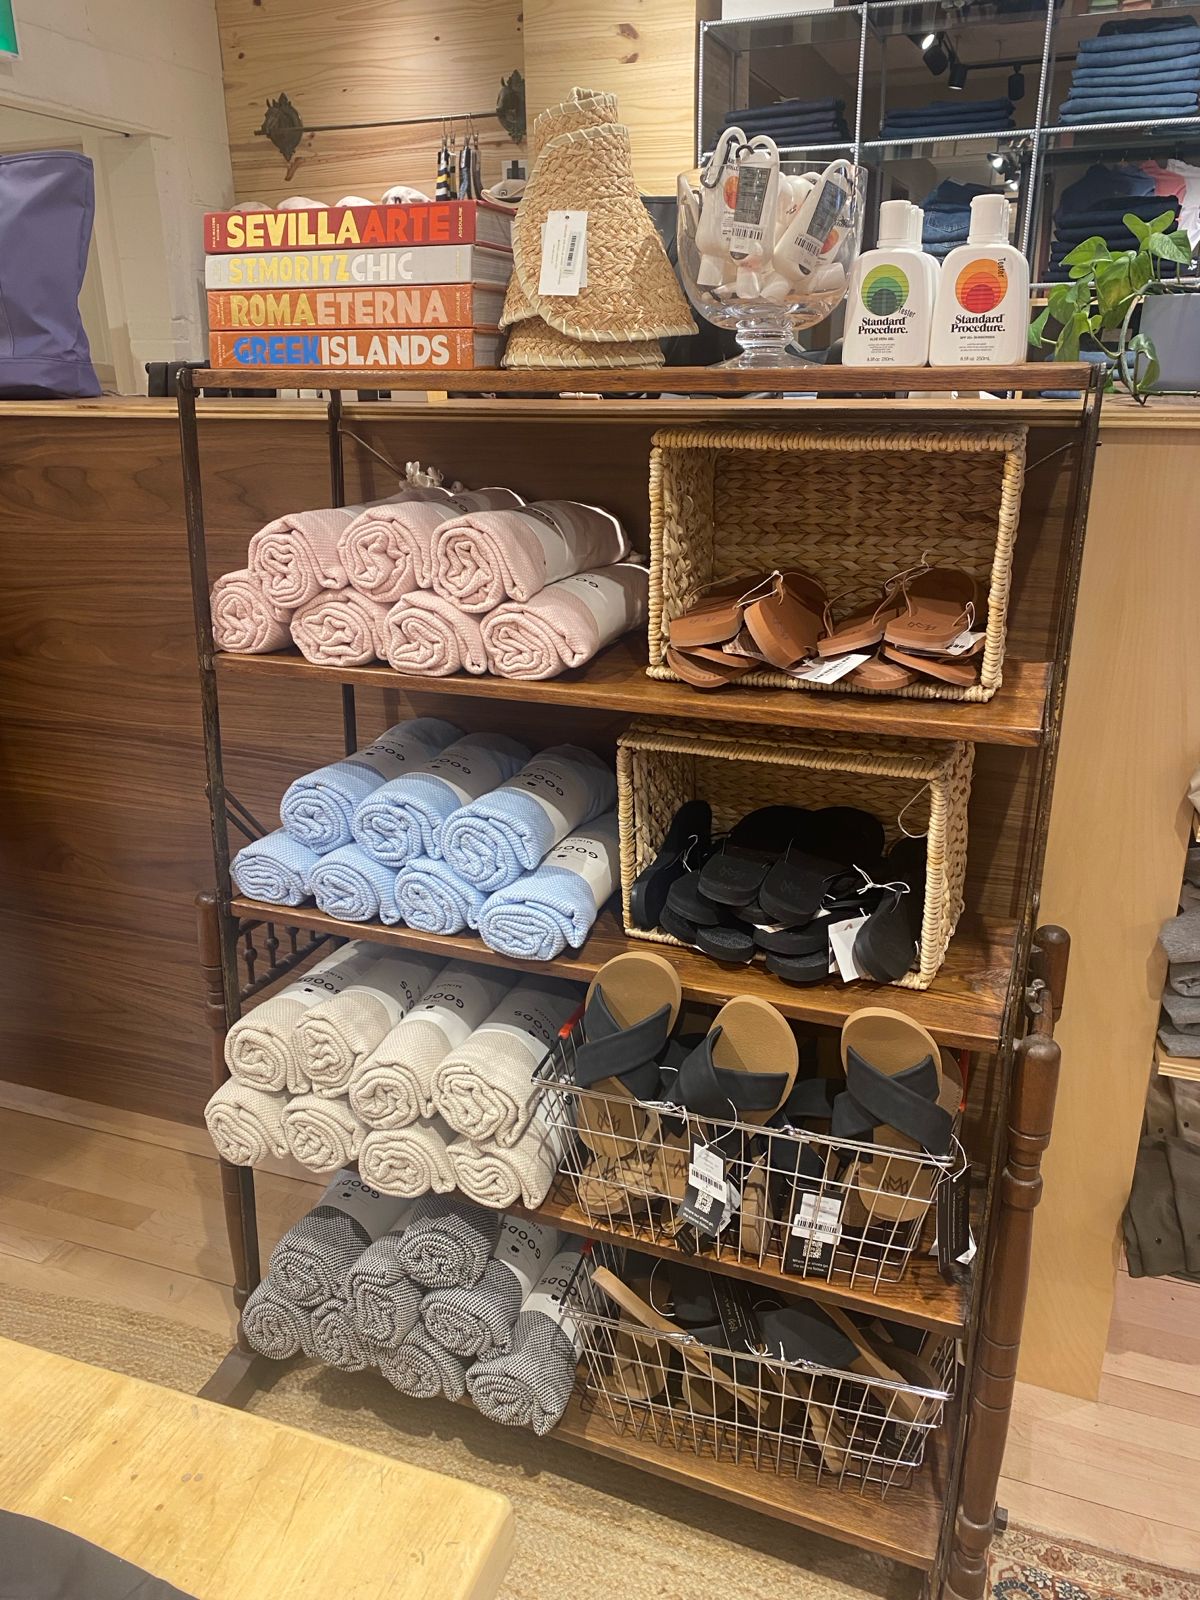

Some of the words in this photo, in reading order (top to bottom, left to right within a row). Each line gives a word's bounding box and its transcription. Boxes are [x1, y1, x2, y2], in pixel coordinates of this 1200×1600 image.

[227, 210, 361, 248] SEVILLA
[361, 206, 450, 243] ARTE
[351, 252, 413, 281] CHIC
[229, 293, 316, 327] ROMA
[316, 289, 448, 325] ETERNA
[861, 316, 907, 326] Standard
[954, 313, 1005, 324] Standard
[857, 325, 909, 334] Procedure.
[950, 323, 1006, 333] Procedure.
[232, 335, 320, 365] GREEK
[320, 334, 450, 366] ISLANDS
[500, 1222, 540, 1260] GOODS
